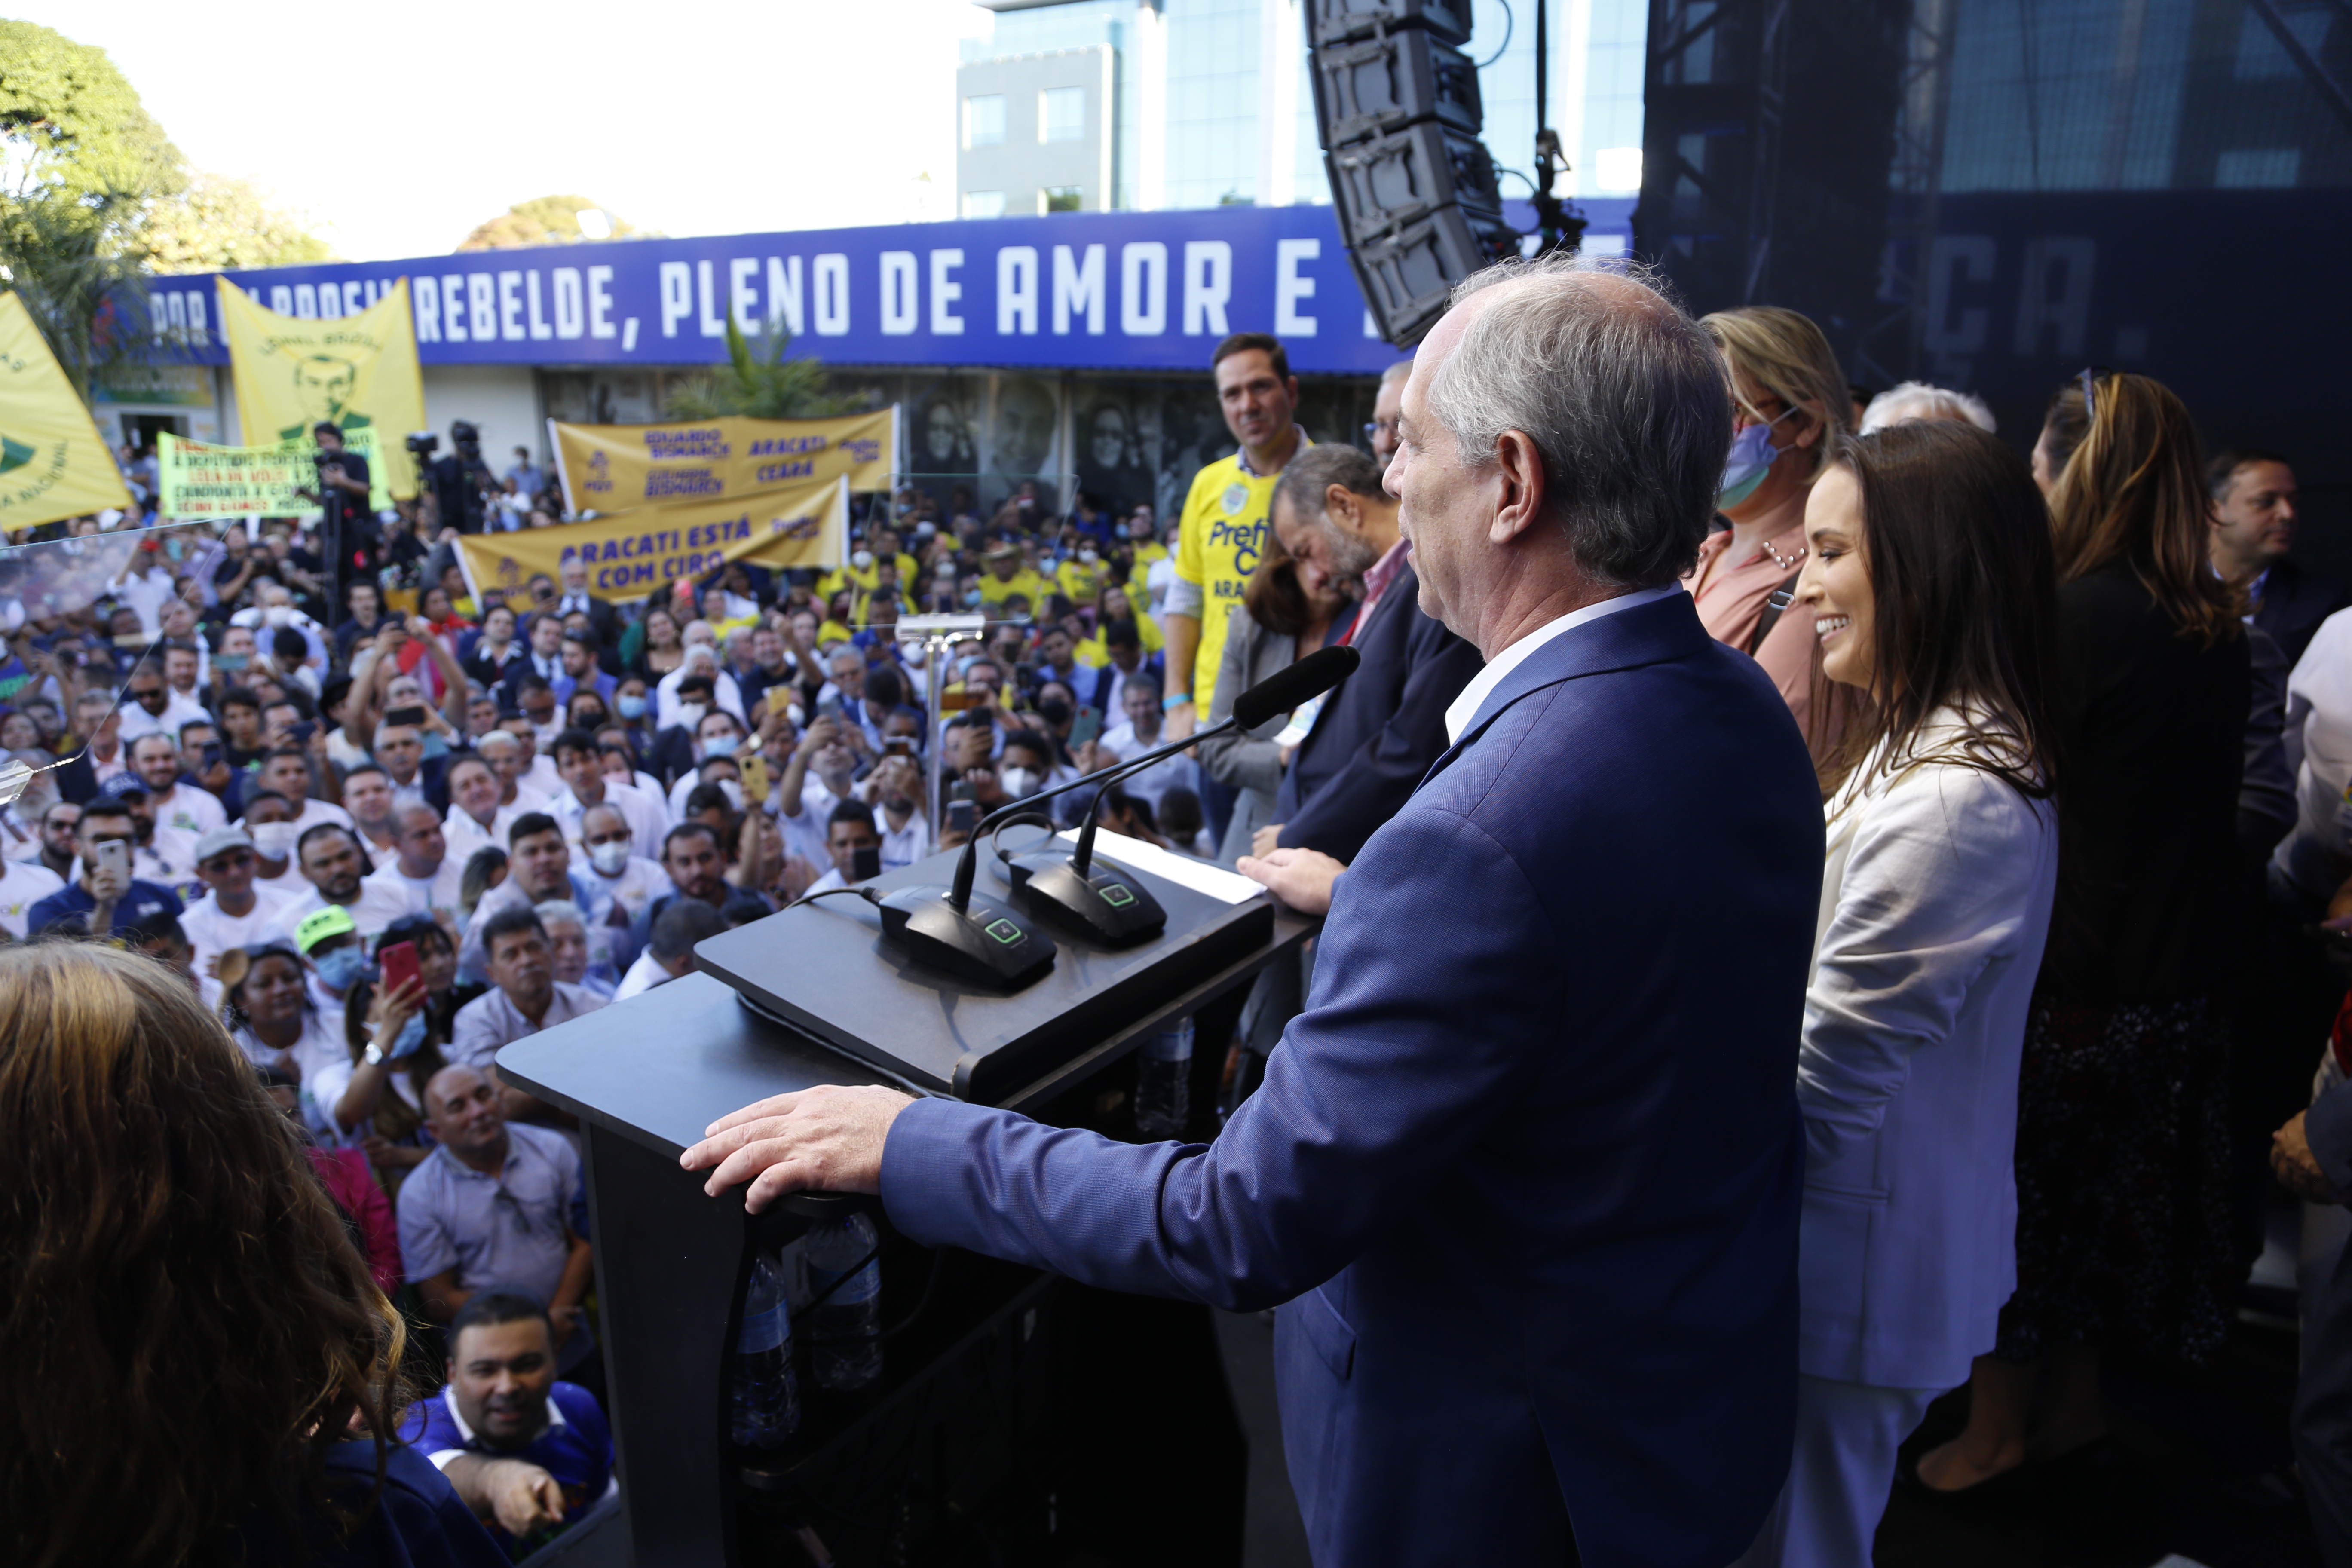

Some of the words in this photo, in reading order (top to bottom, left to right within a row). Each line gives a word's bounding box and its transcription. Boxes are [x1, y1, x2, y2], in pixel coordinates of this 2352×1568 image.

[413, 265, 640, 352] REBELDE,
[660, 253, 851, 337] PLENO
[880, 248, 965, 336] DE
[996, 240, 1232, 336] AMOR
[1274, 238, 1321, 337] E
[748, 435, 826, 456] ARACATI
[560, 529, 680, 566] ARACATI
[688, 512, 751, 548] ESTÁ
[597, 564, 654, 589] COM
[663, 550, 724, 579] CIRO
